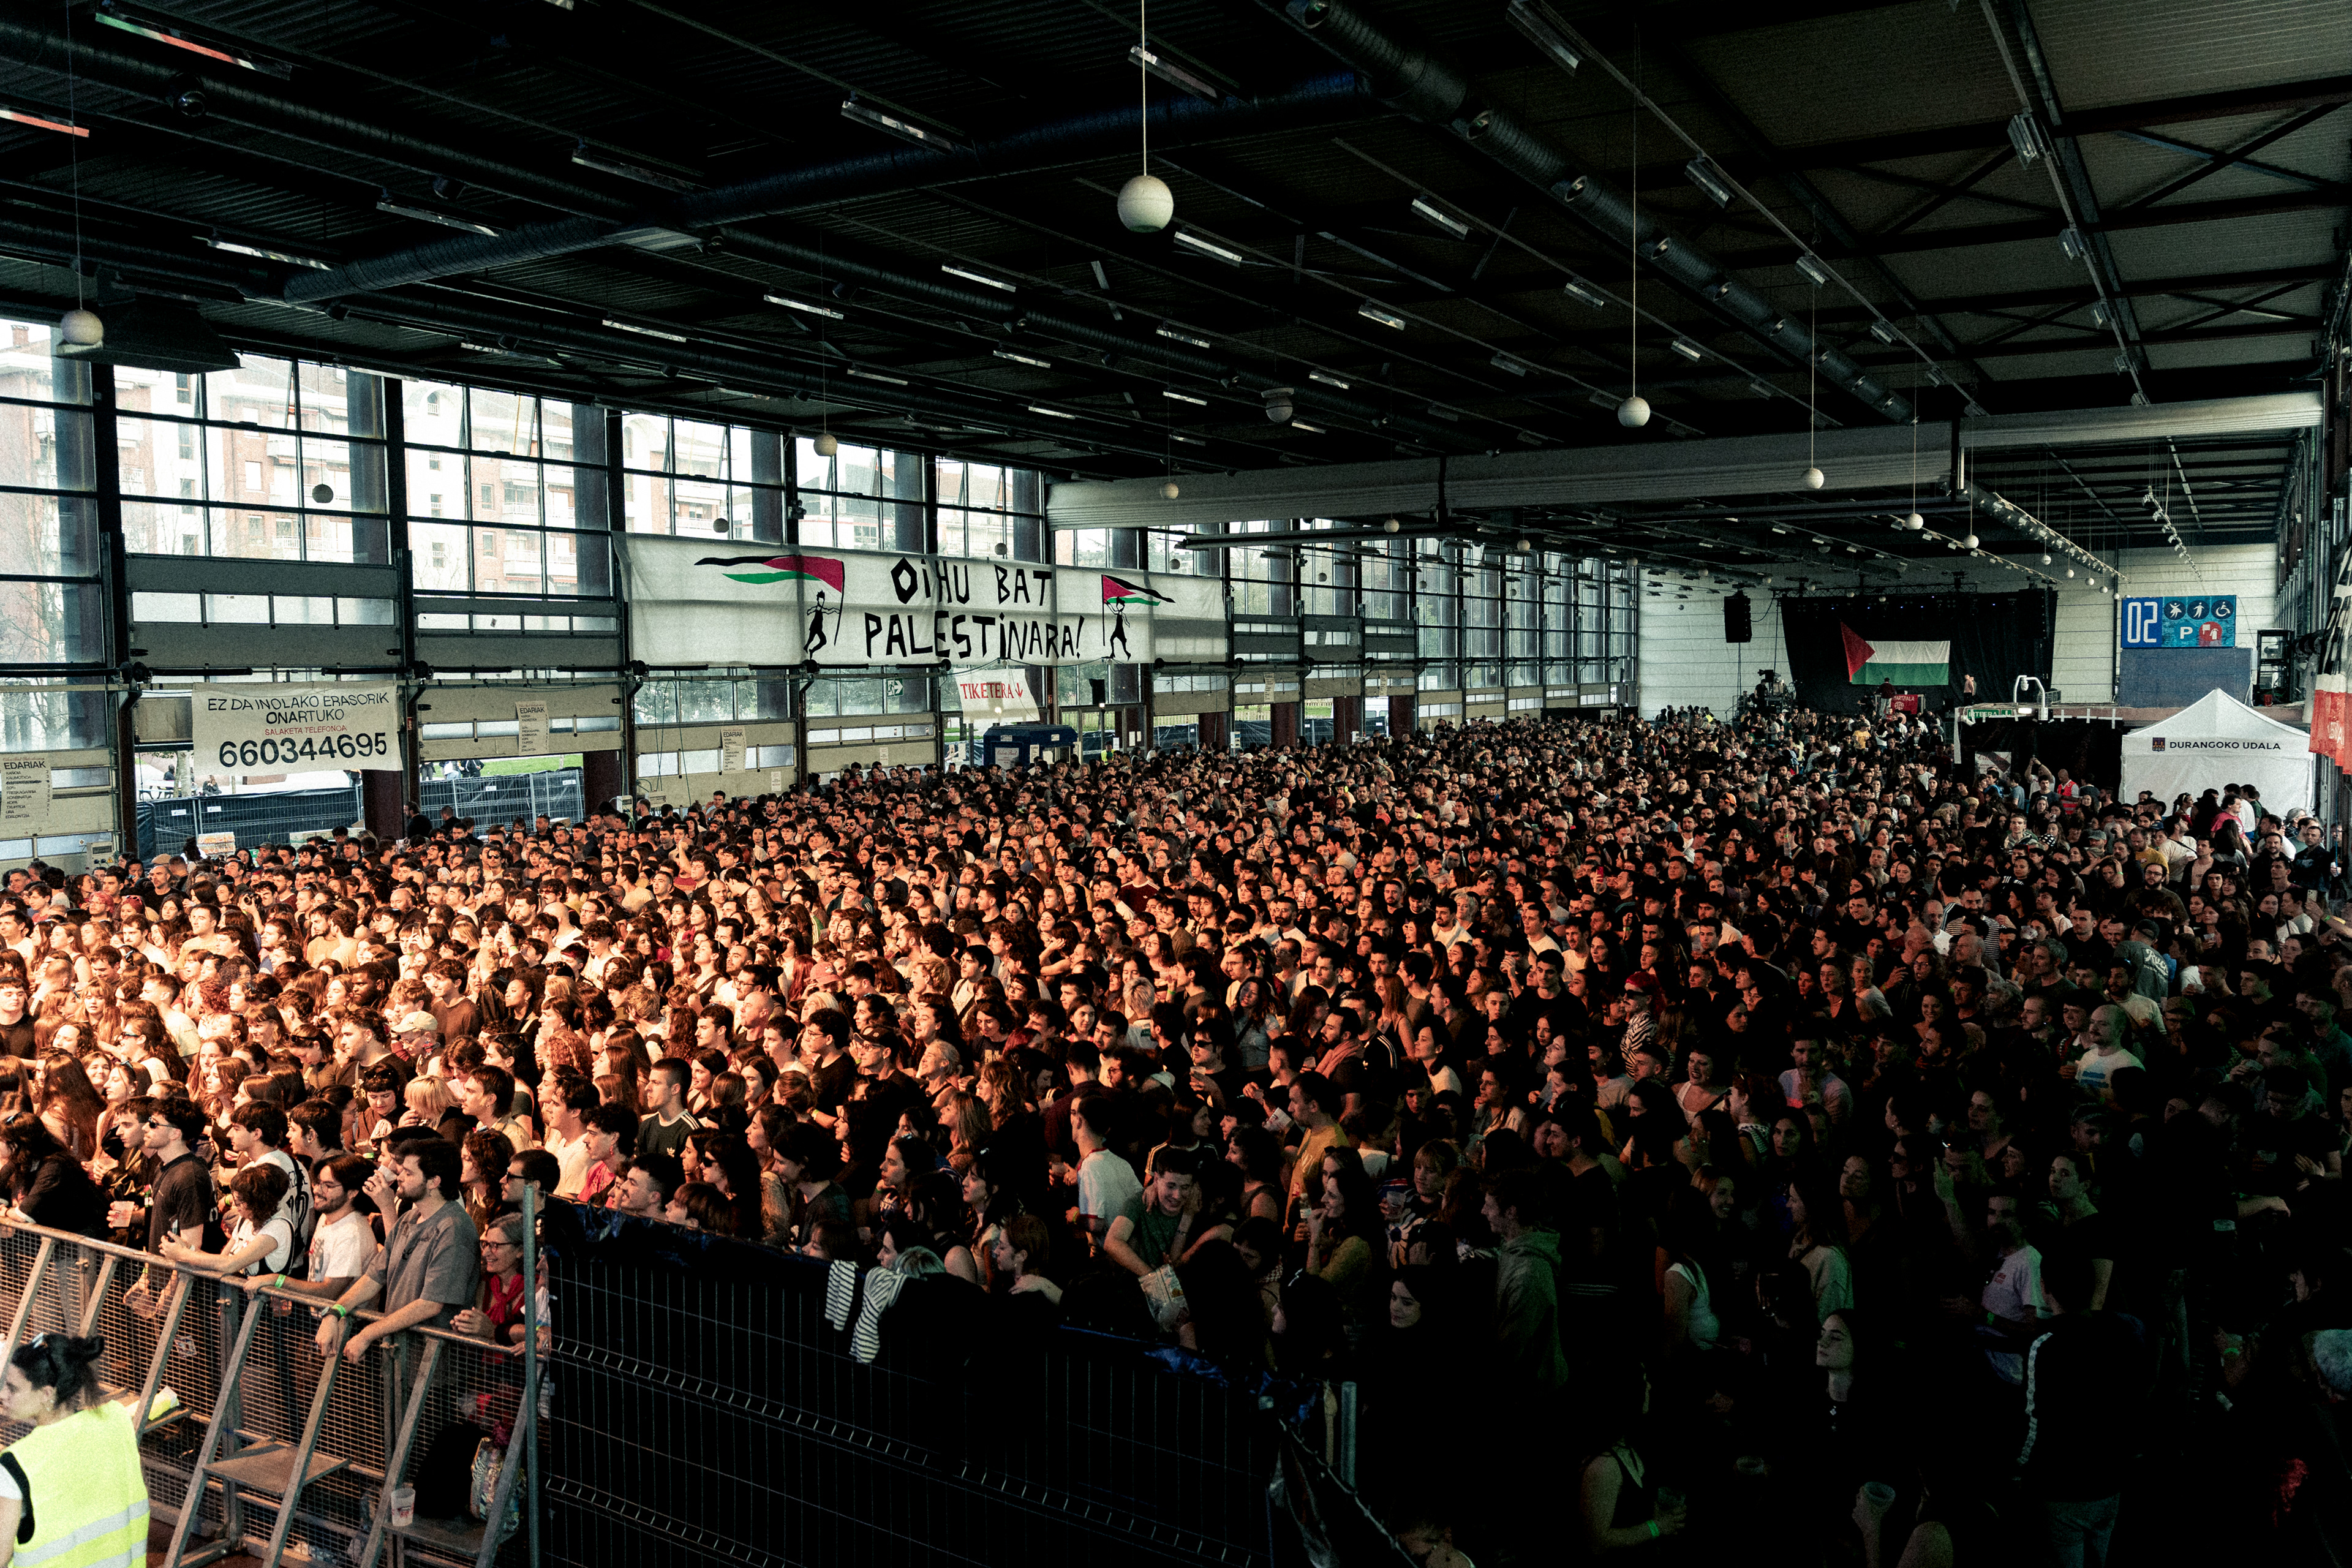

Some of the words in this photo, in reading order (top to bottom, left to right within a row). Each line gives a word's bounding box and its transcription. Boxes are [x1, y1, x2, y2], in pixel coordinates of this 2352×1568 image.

[994, 564, 1052, 606] BAT
[2128, 601, 2158, 643] 02
[2180, 627, 2193, 639] P
[960, 683, 1014, 699] TIKETERA
[208, 698, 227, 710] EZ
[231, 698, 253, 710] DA
[257, 695, 319, 710] INOLAKO
[323, 692, 390, 707] ERASORIK
[266, 709, 345, 725] ONARTUKO
[265, 726, 304, 736] SALAKETA
[305, 725, 347, 734] TELEFONOA
[219, 732, 387, 767] 660344695
[2243, 742, 2281, 750] UDALA
[4, 761, 46, 769] EDARIAK
